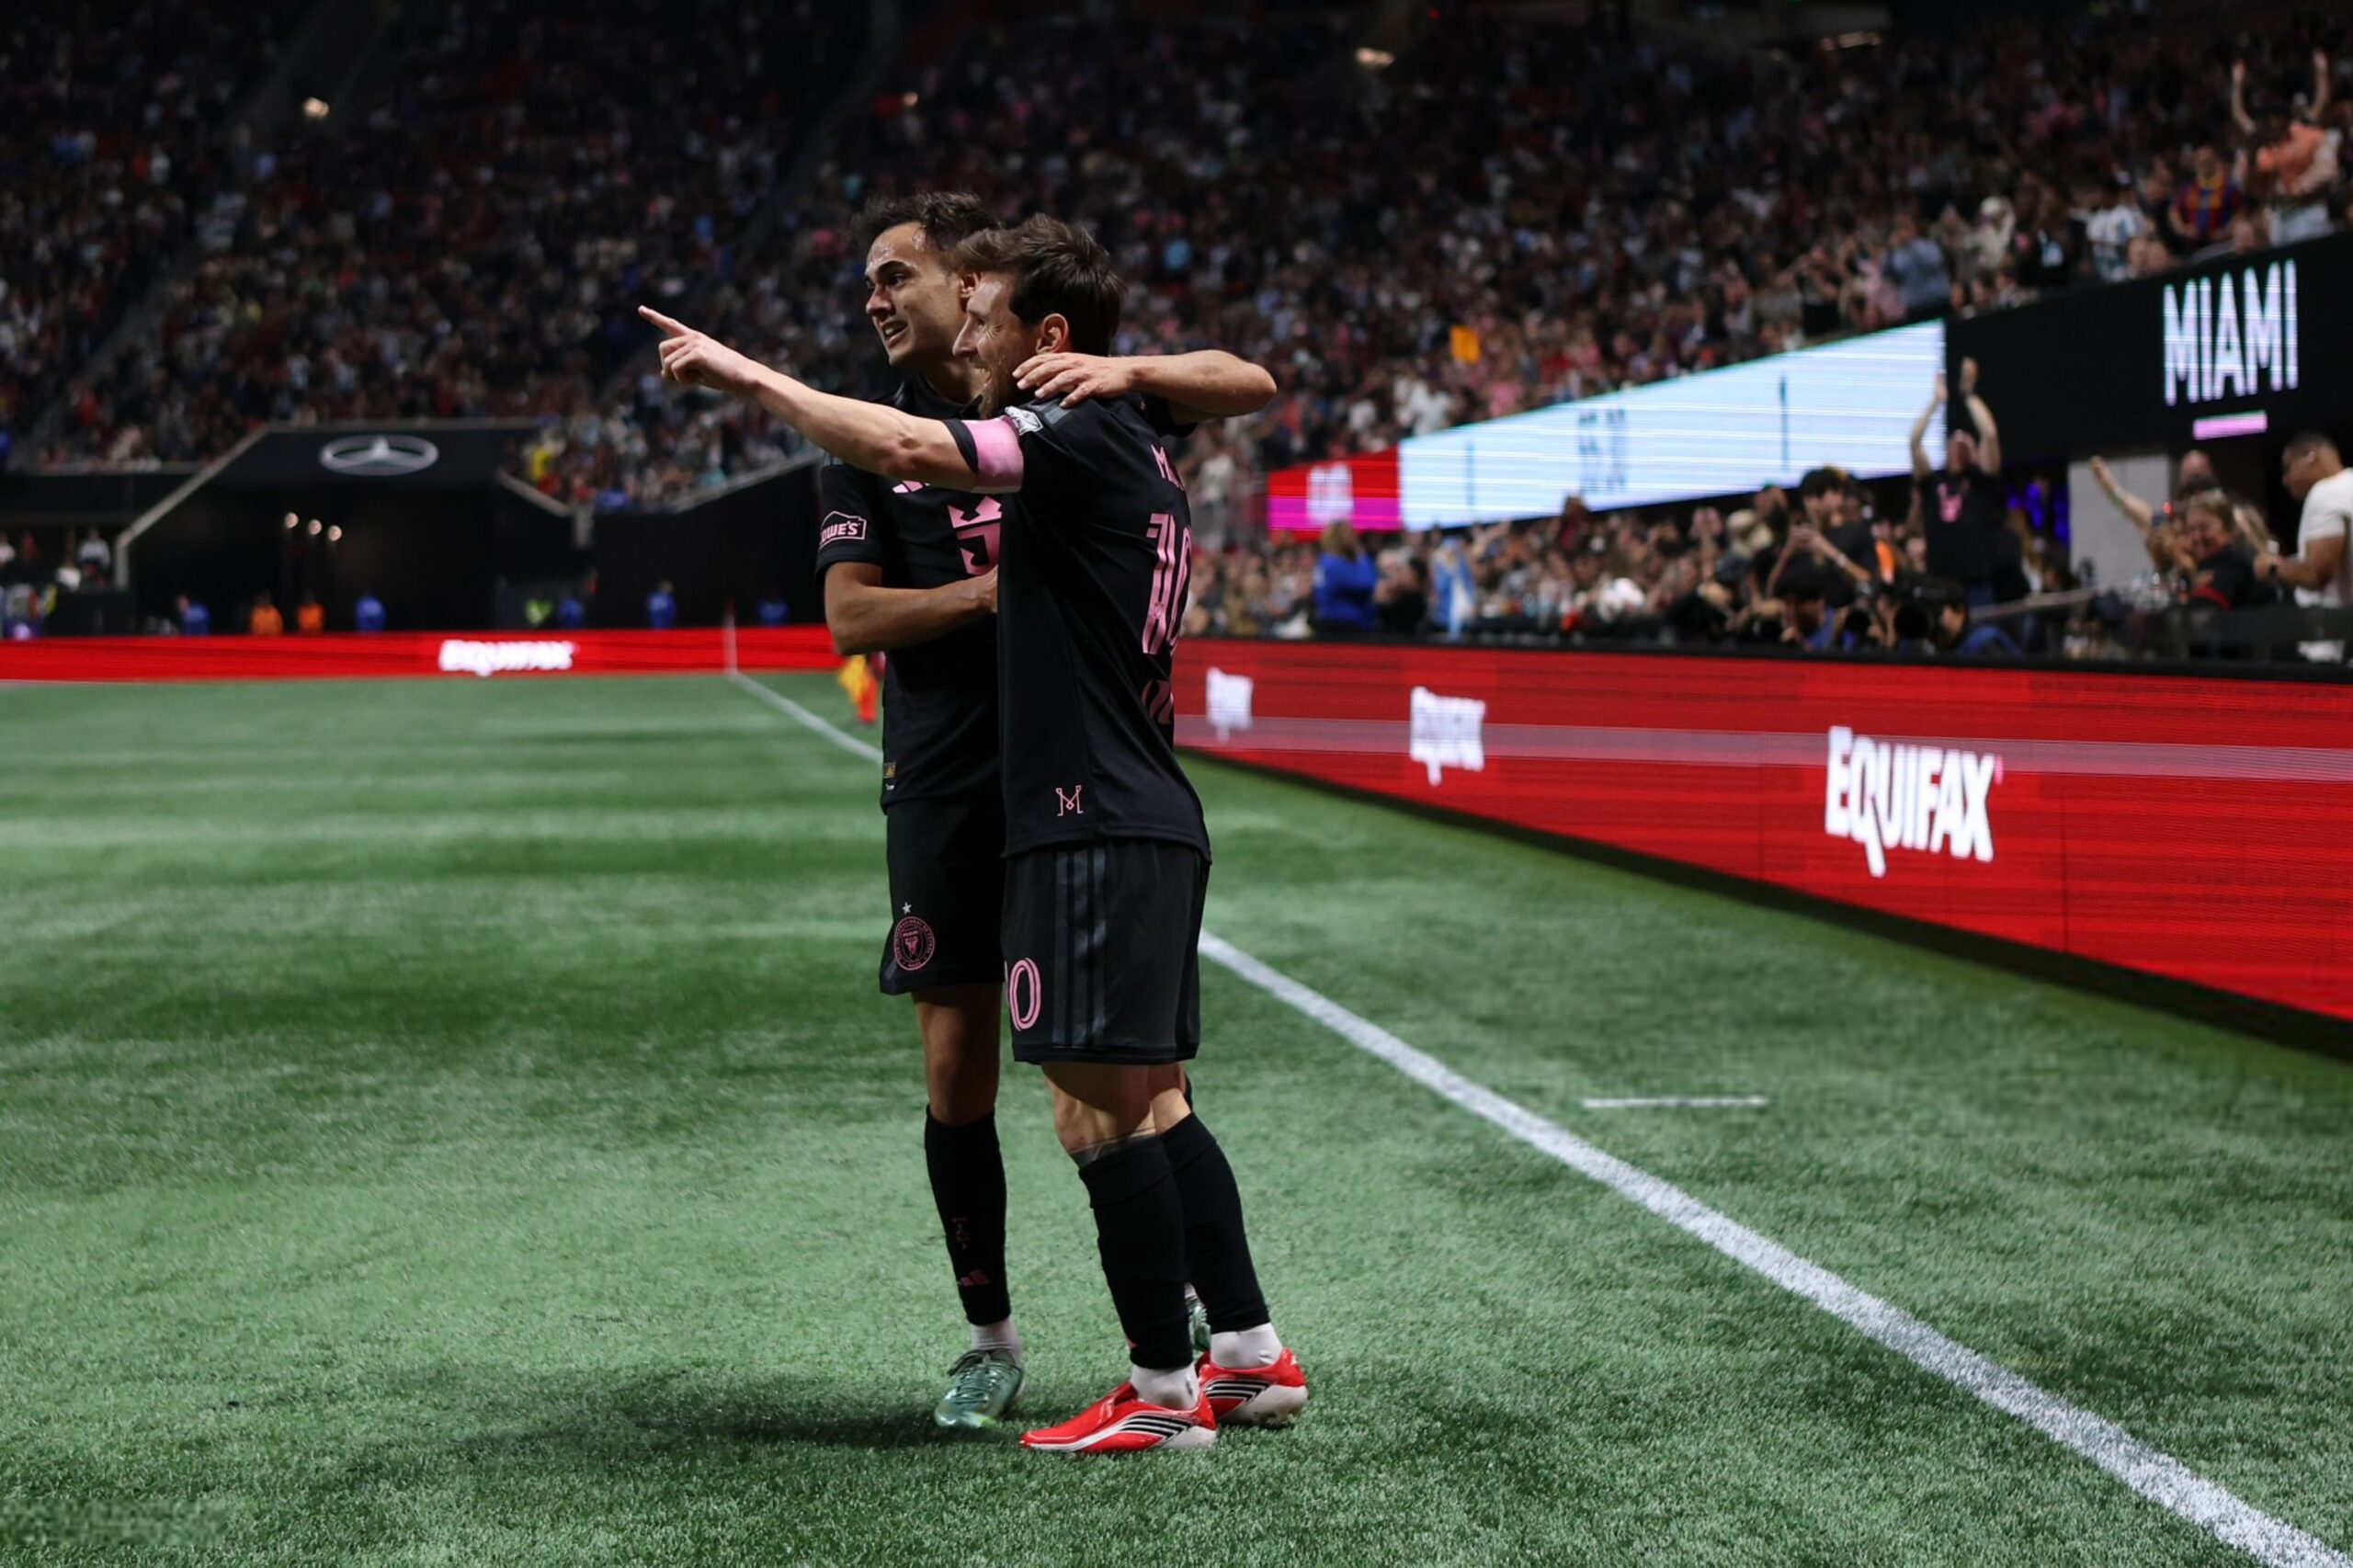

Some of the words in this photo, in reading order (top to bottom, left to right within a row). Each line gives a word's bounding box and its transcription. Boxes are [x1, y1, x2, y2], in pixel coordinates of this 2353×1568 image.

[2164, 258, 2298, 406] MIAMI
[820, 521, 858, 544] OWE'S
[1825, 725, 1995, 878] EQUIFAX
[1004, 957, 1042, 1031] 0
